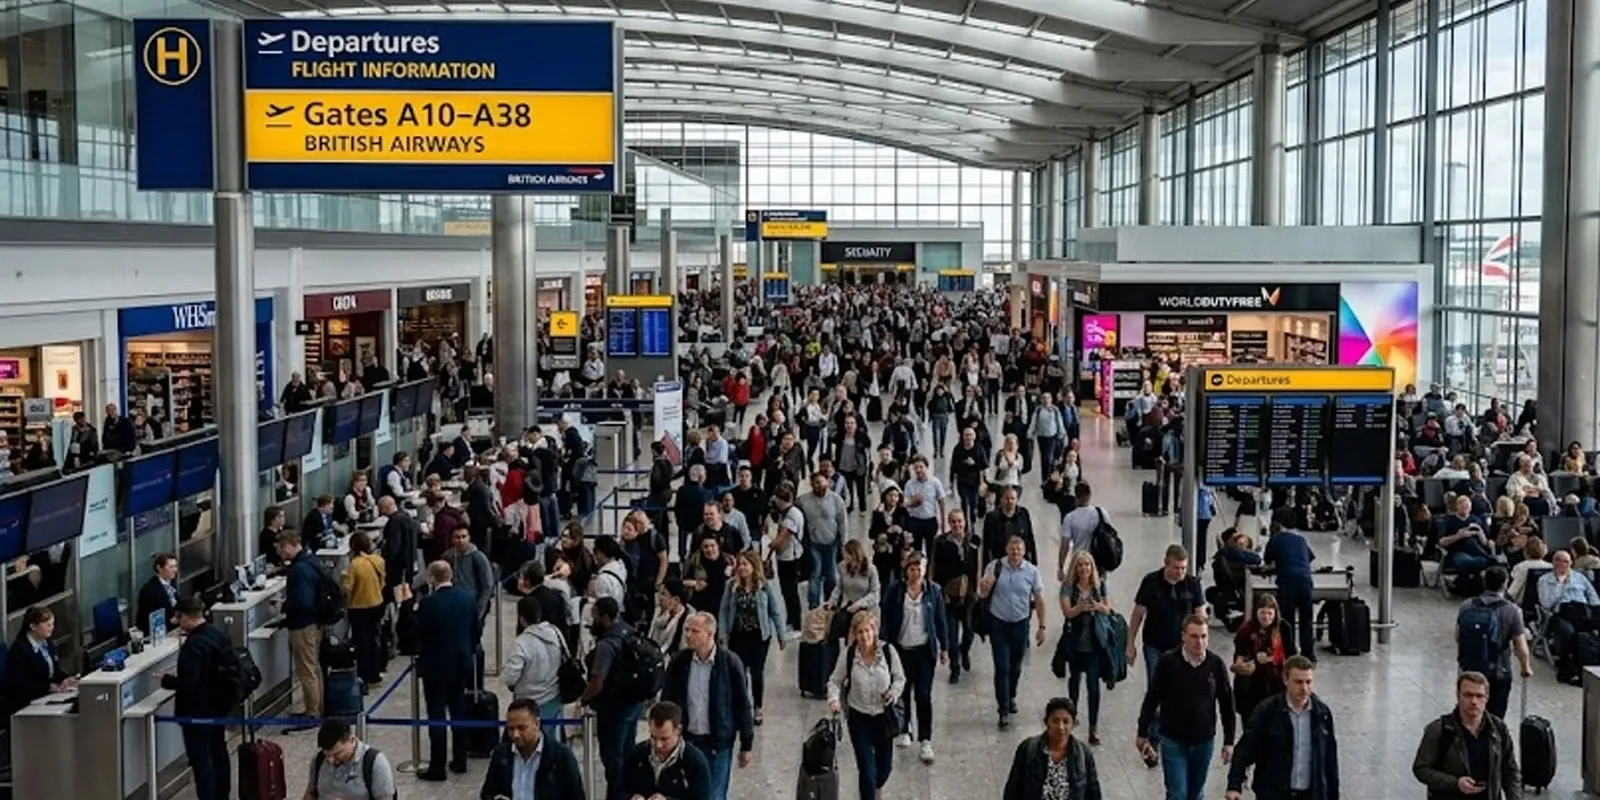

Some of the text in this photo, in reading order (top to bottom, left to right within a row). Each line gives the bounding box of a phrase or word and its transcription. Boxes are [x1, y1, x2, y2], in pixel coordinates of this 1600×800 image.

[292, 30, 440, 55] Departures
[157, 37, 187, 75] H
[292, 62, 495, 79] FLIGHT INFORMATION
[304, 102, 531, 128] Gates A10–A38
[305, 136, 485, 153] BRITISH AIRWAYS
[1226, 373, 1291, 387] Departures
